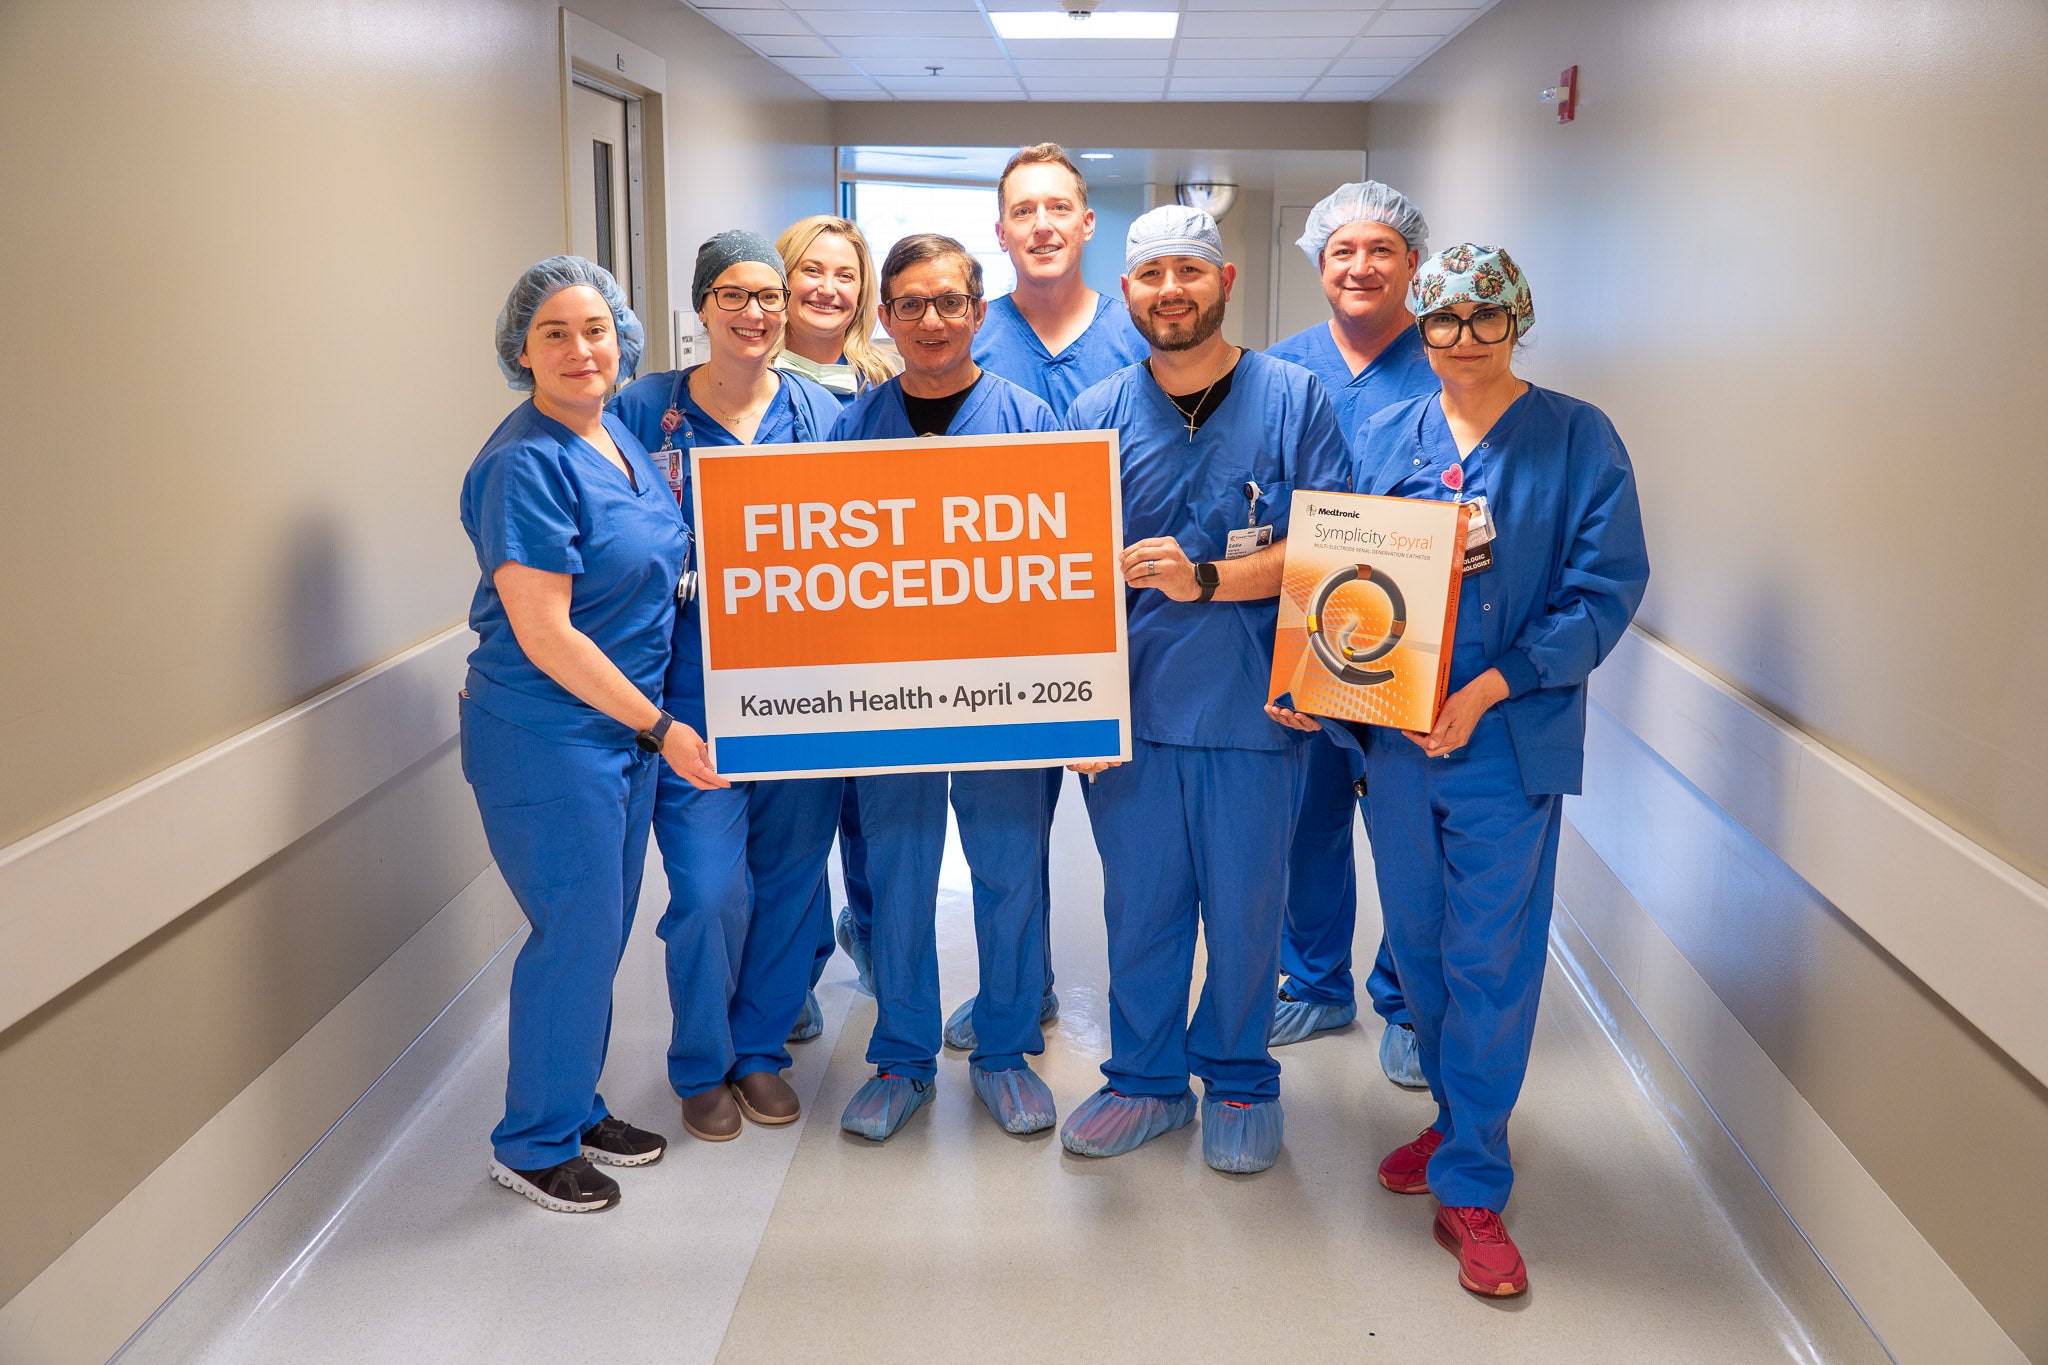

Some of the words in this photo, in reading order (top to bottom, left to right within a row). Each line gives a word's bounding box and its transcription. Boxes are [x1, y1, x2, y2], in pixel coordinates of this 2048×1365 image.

[743, 498, 916, 552] FIRST
[942, 492, 1067, 544] RDN
[1318, 508, 1360, 518] Medtronic
[1315, 523, 1387, 548] Symplicity
[1390, 531, 1433, 552] Spyral
[1372, 549, 1405, 558] DENERVATION
[1405, 552, 1431, 561] CATHETER
[1464, 553, 1485, 565] OLOGIC
[723, 552, 1095, 615] PROCEDURE
[740, 690, 843, 717] Kaweah
[849, 686, 933, 712] Health
[952, 682, 1013, 713] April
[1031, 681, 1093, 704] 2026
